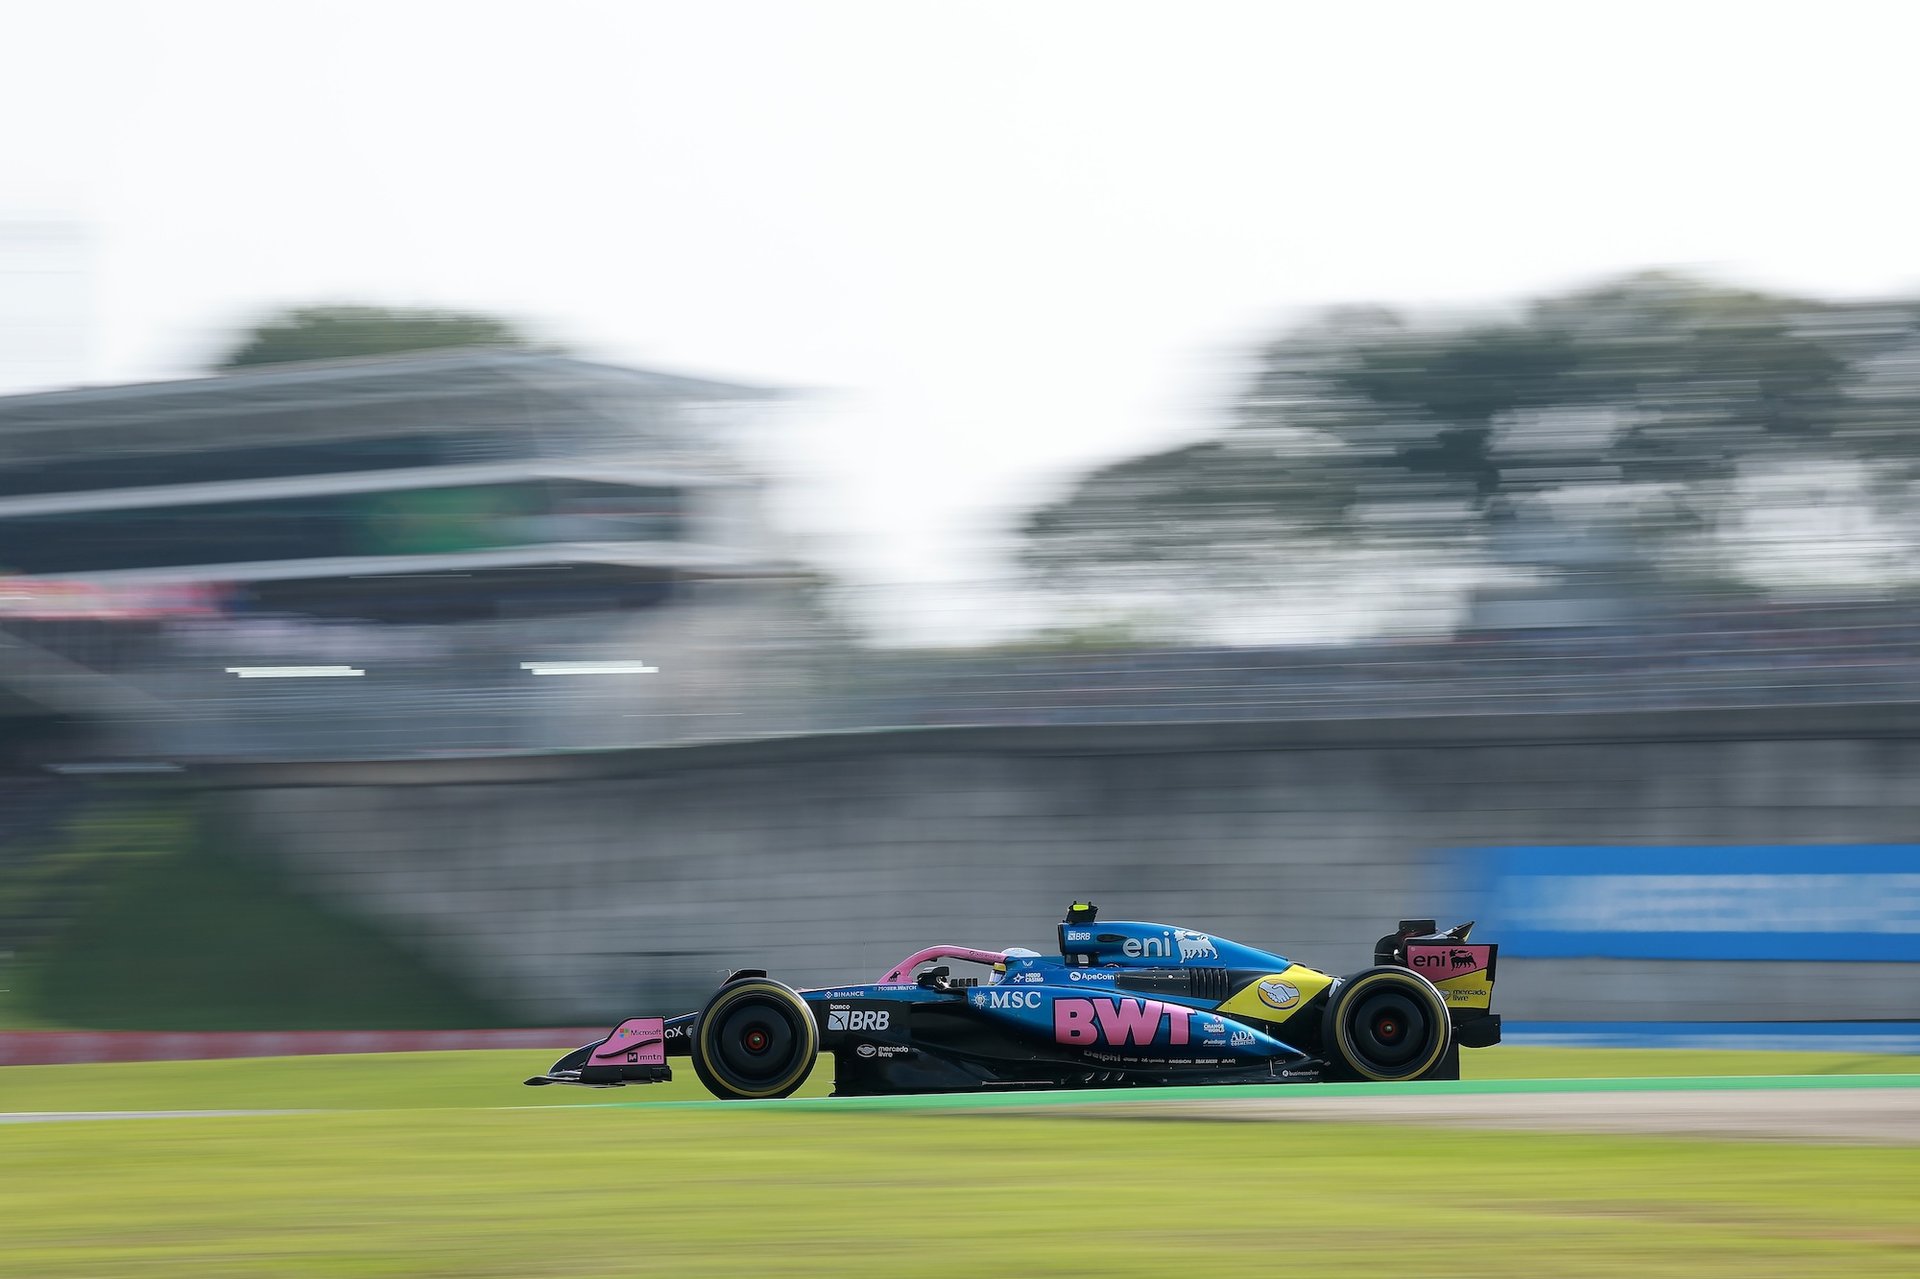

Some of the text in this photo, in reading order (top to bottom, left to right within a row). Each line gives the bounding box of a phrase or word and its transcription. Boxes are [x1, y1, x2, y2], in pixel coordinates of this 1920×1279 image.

[1076, 932, 1091, 941] BRB
[1122, 931, 1171, 958] eni
[1413, 951, 1446, 967] eni
[1082, 973, 1115, 981] ApeCoin
[989, 991, 1042, 1009] MSC
[849, 1010, 890, 1031] BRB
[1054, 998, 1197, 1046] BWT
[630, 1028, 662, 1036] Microsoft
[1231, 1031, 1254, 1041] ADA
[1083, 1049, 1121, 1062] Delphi
